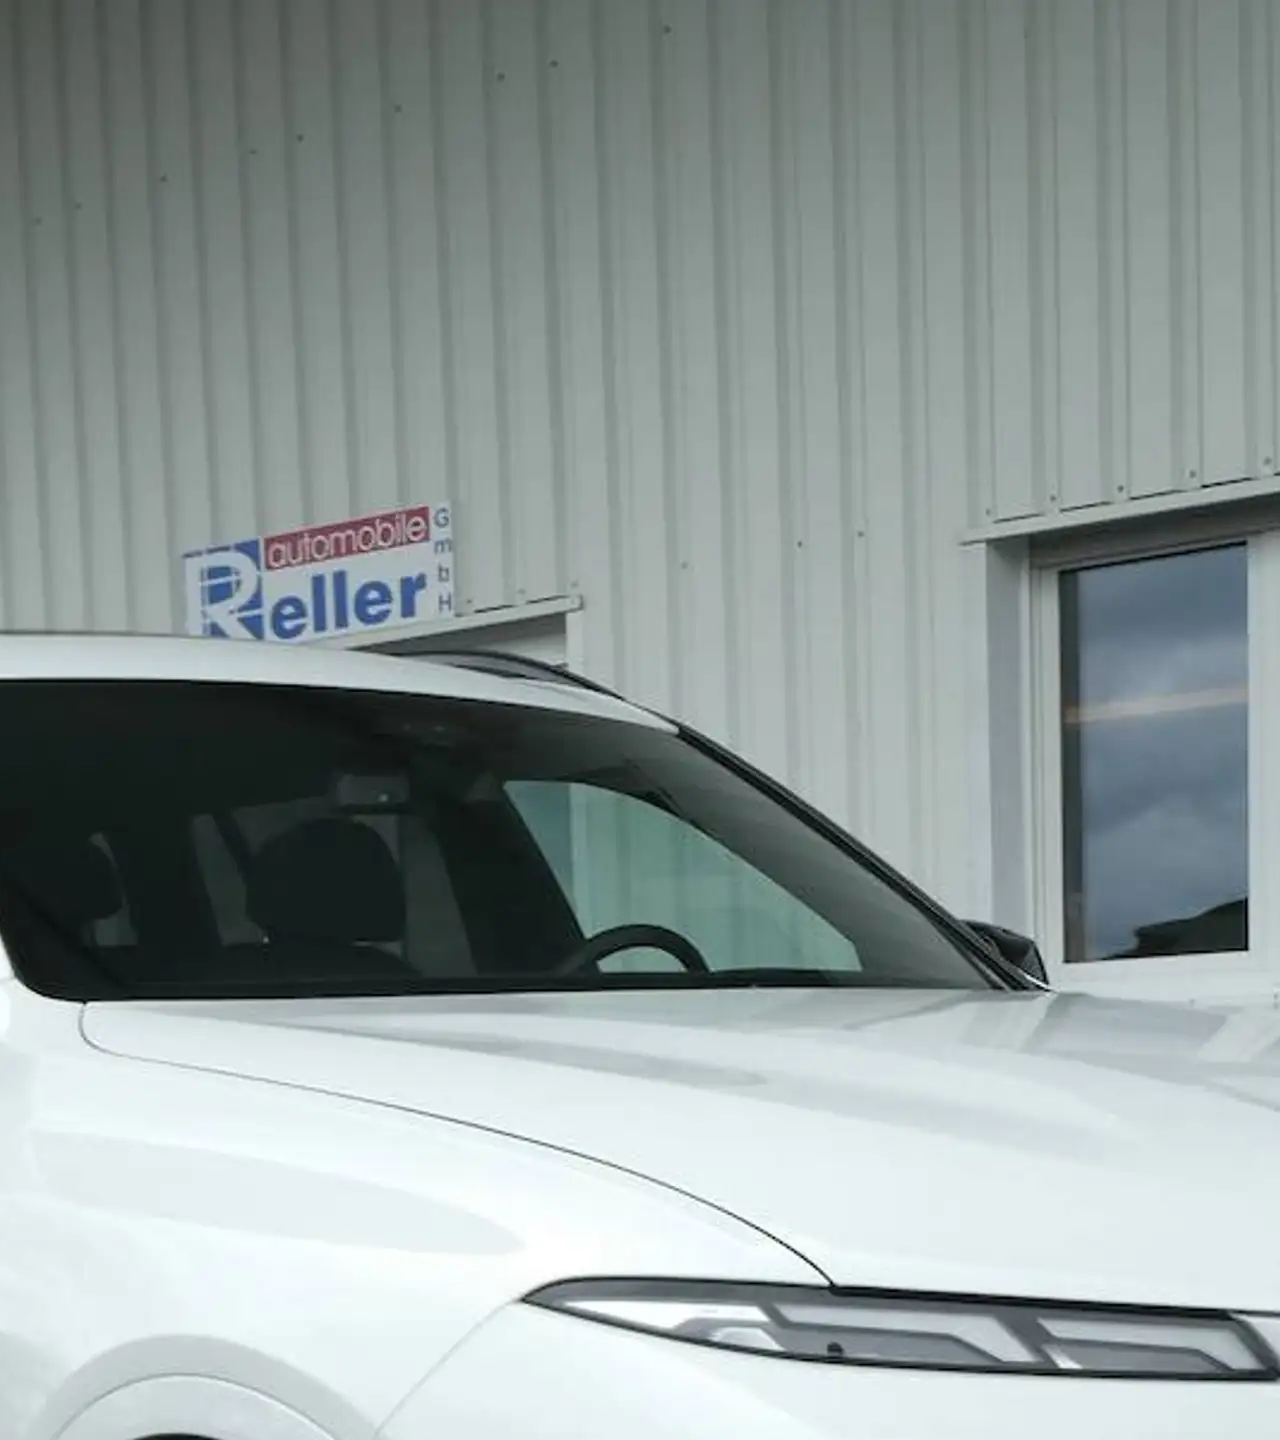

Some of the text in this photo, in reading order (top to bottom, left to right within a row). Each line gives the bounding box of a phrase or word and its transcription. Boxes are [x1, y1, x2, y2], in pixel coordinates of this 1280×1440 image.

[268, 512, 427, 569] automobile
[433, 506, 453, 613] GmbH
[184, 541, 428, 641] Reller
